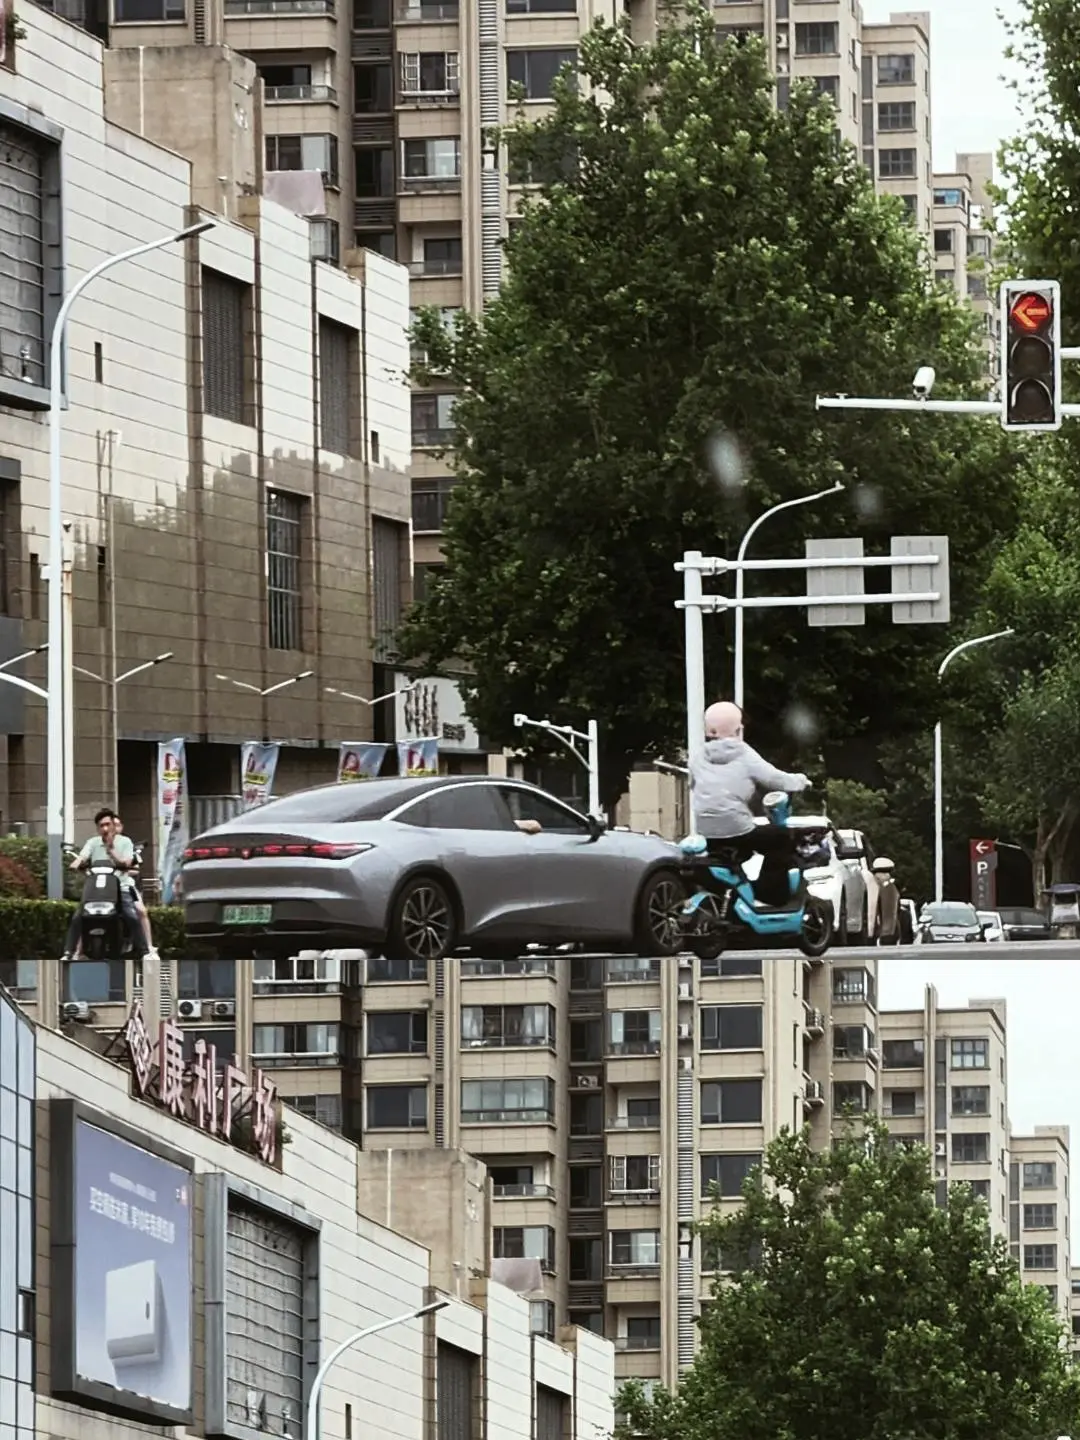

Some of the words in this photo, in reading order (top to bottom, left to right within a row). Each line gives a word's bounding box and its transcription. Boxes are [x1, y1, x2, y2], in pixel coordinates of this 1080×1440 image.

[977, 861, 988, 875] P
[159, 1017, 276, 1164] 康利广场
